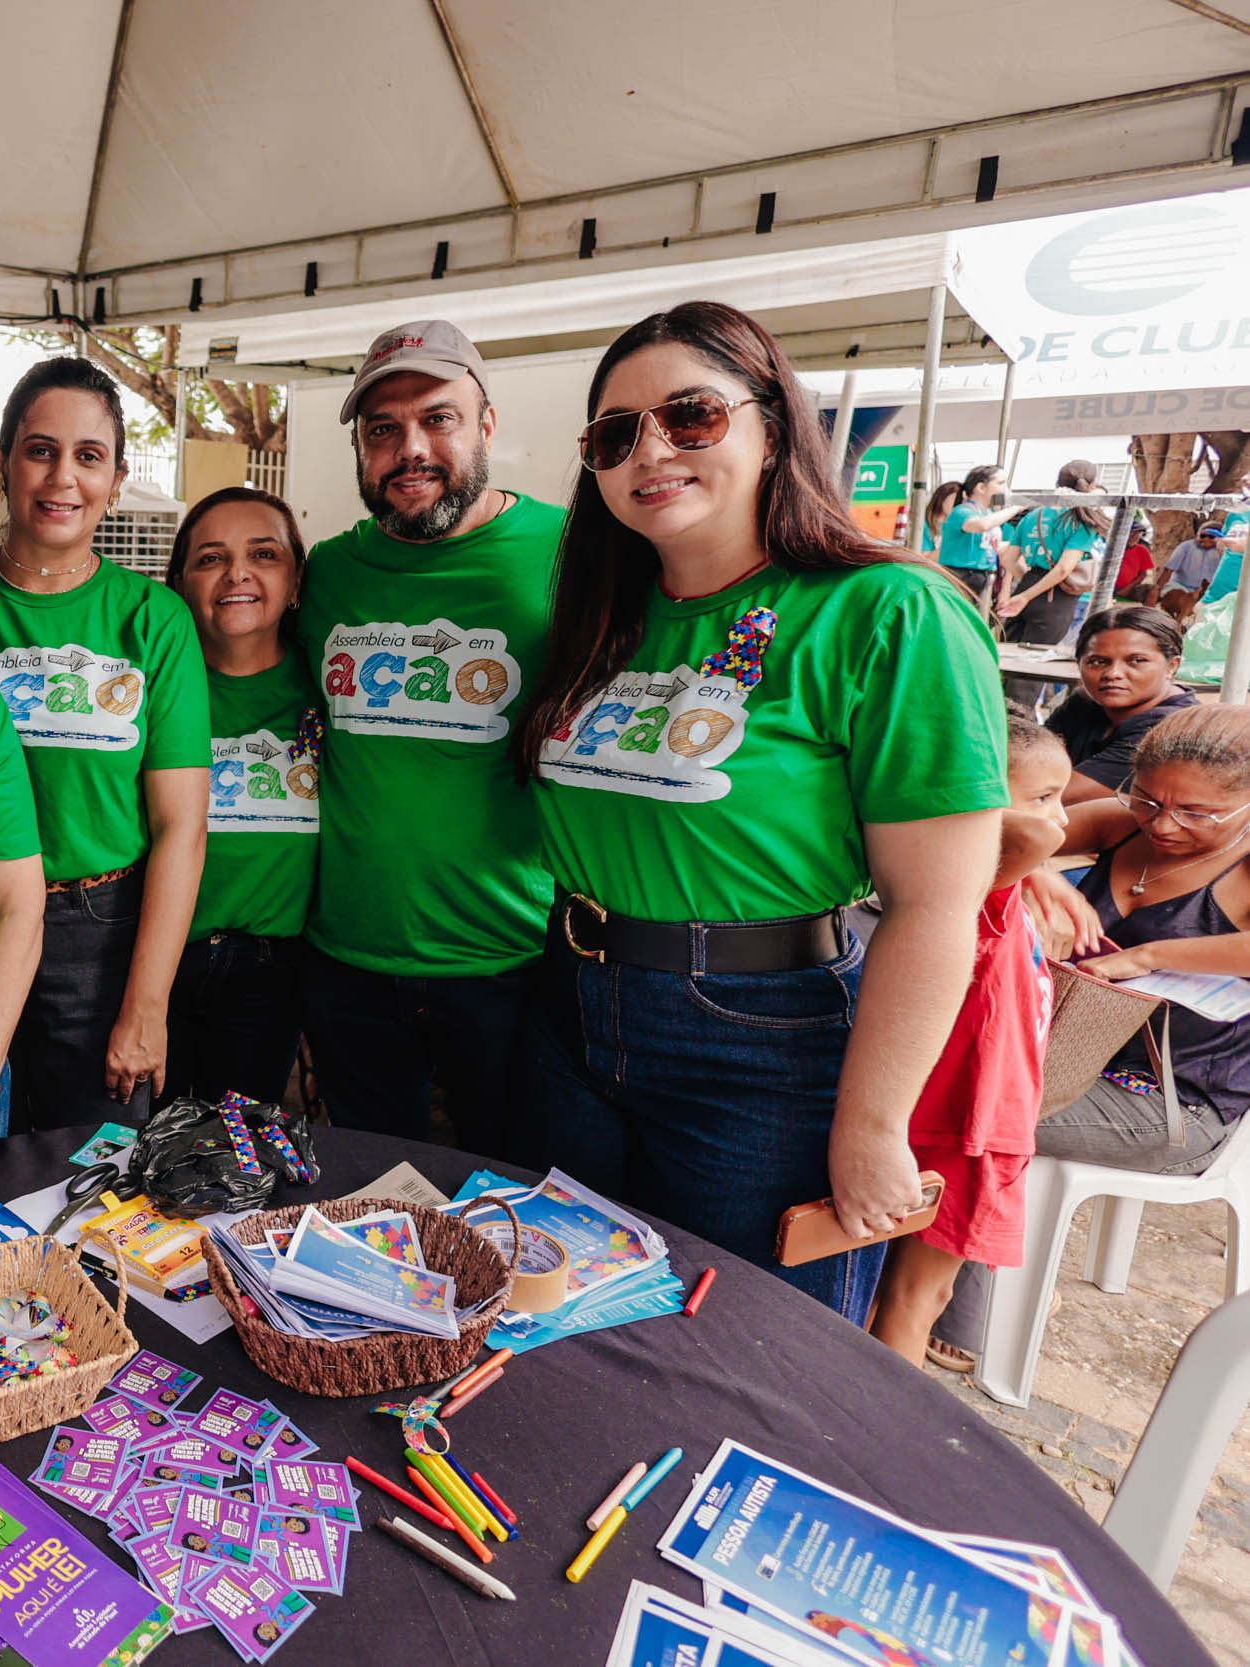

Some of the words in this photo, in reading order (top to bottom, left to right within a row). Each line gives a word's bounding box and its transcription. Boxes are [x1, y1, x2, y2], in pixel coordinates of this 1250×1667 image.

[330, 632, 406, 647] Assembleia
[469, 638, 495, 650] em
[102, 662, 125, 672] em
[698, 685, 731, 701] em
[124, 1213, 150, 1232] RADEX
[179, 1246, 194, 1257] 12
[712, 1518, 752, 1567] PESSOA
[739, 1475, 778, 1522] AUTISTA
[50, 1553, 87, 1582] LEI
[46, 1577, 65, 1593] É
[14, 1587, 53, 1627] AQUI
